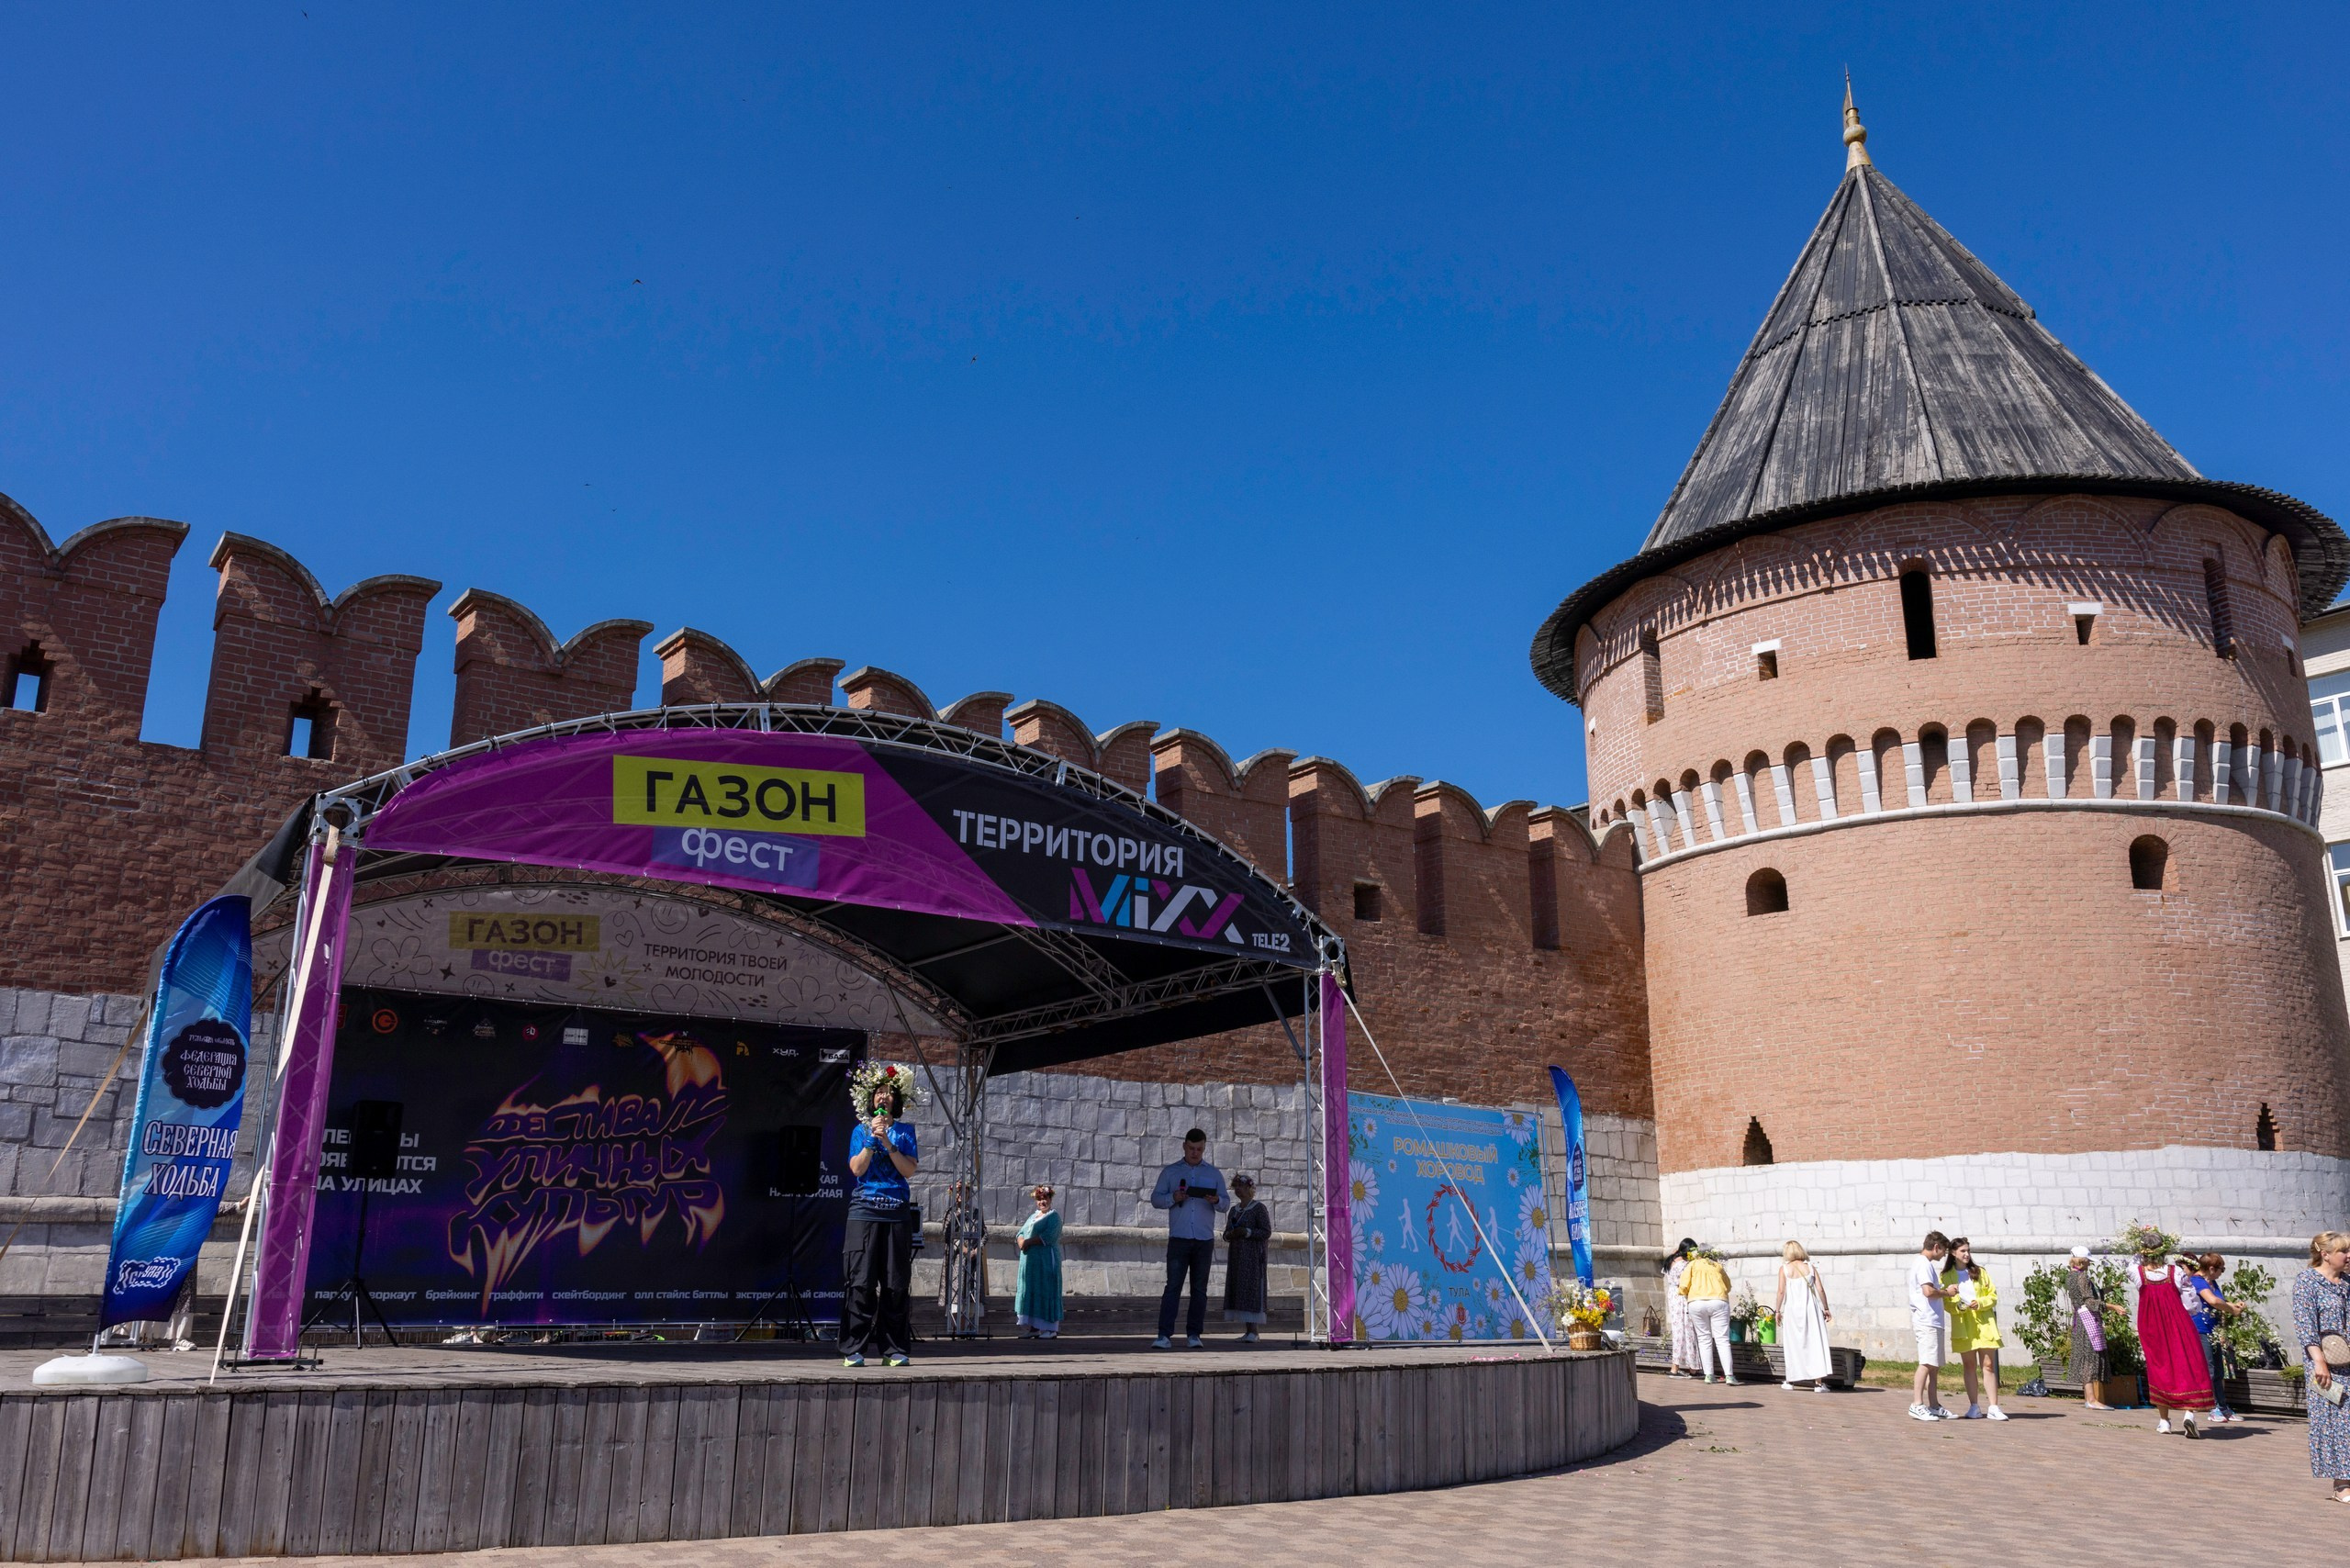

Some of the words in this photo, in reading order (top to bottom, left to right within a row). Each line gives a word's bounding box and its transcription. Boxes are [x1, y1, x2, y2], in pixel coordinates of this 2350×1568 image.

[645, 770, 837, 823] ГАЗОН
[681, 826, 794, 872] фест
[952, 809, 1184, 879] ТЕРРИТОРИЯ
[467, 918, 583, 946] ГАЗОН
[1252, 933, 1291, 953] TELE2
[488, 949, 555, 974] фест
[643, 943, 735, 967] ТЕРРИТОРИЯ
[739, 951, 788, 971] ТВОЕЙ
[666, 966, 765, 988] МОЛОДОСТИ
[180, 1049, 238, 1066] ФЕДЕРАЦИЯ
[828, 1053, 849, 1061] БАЗА
[183, 1063, 232, 1080] СЕВЕРНОЙ
[185, 1076, 228, 1092] ХОДЬБЫ
[142, 1119, 239, 1160] СЕВЕРНАЯ
[1393, 1137, 1498, 1164] РОМАШКОВЫЙ
[143, 1161, 221, 1199] ХОДЬБА
[1416, 1159, 1485, 1184] ХОРОВОД
[341, 1176, 423, 1195] УЛИЦАХ
[369, 1290, 417, 1302] воркаут
[425, 1289, 480, 1301] брейкинг
[488, 1290, 544, 1302] граффити
[552, 1289, 628, 1302] скейтбординг
[634, 1291, 654, 1300] олл
[655, 1290, 690, 1300] стайлс
[692, 1289, 729, 1300] баттлы
[1449, 1287, 1471, 1297] ТУЛА
